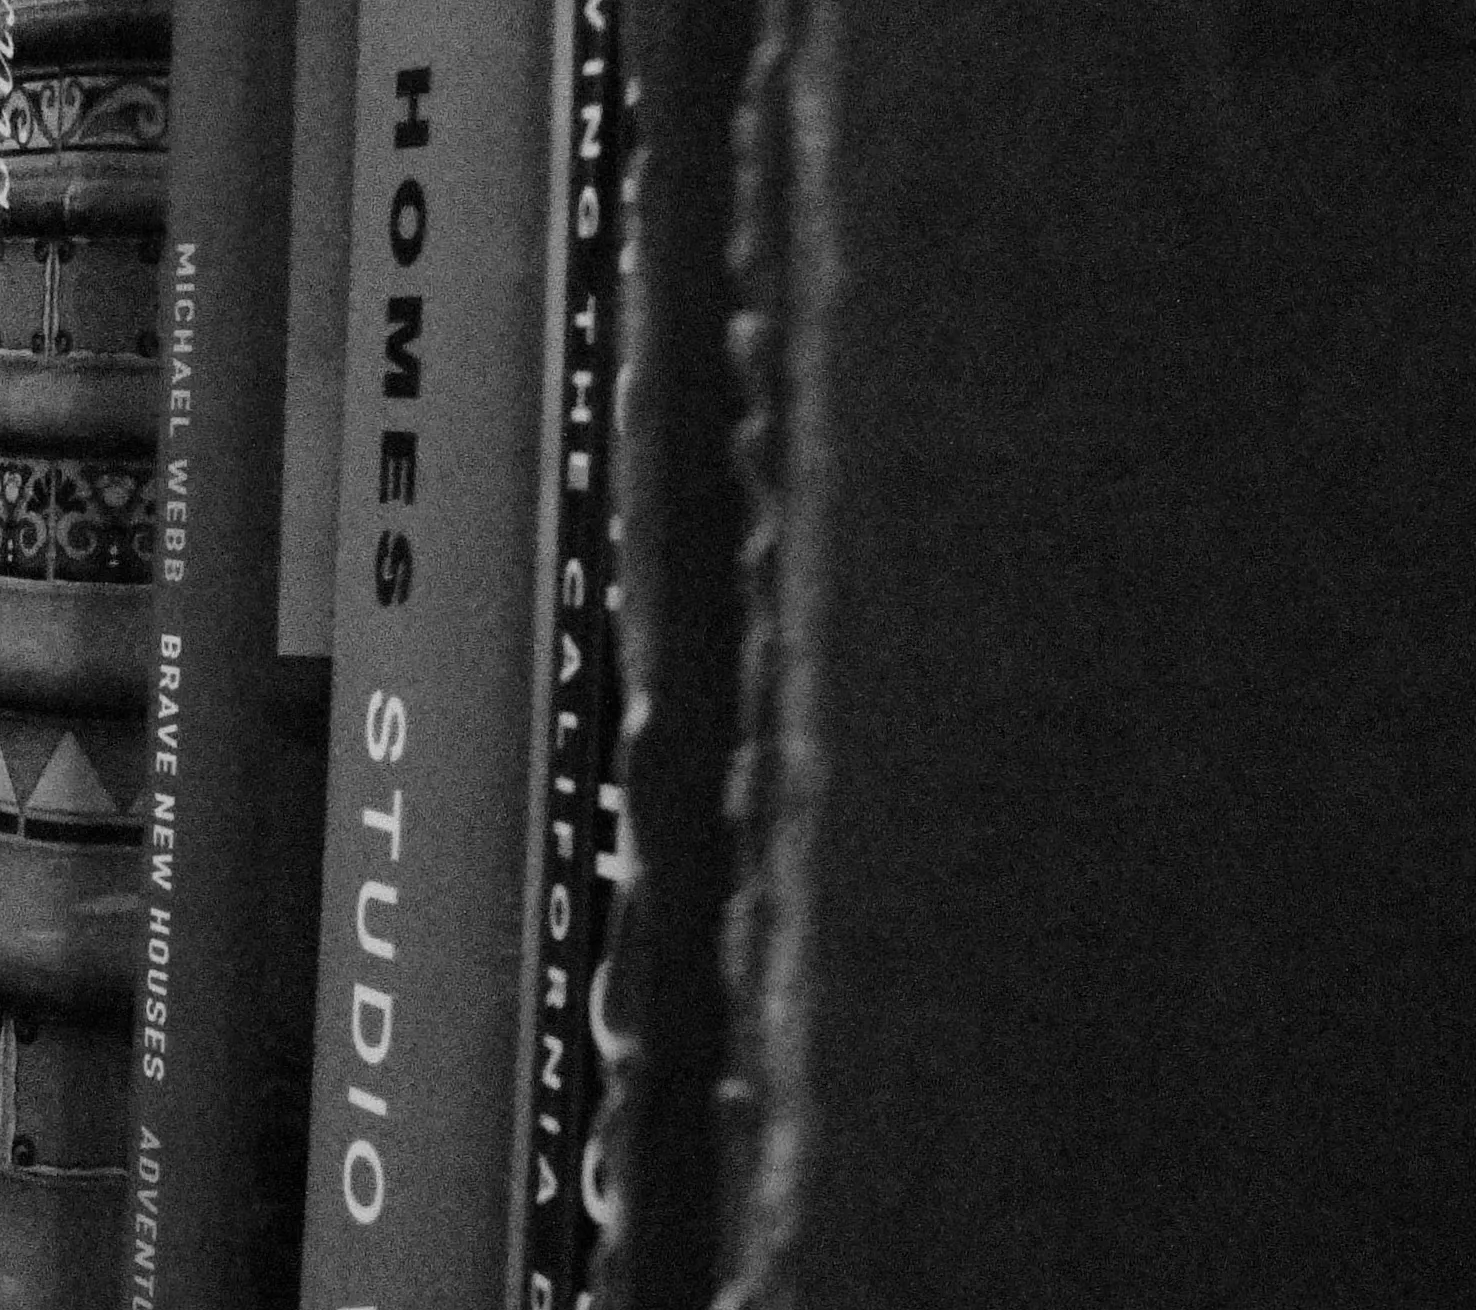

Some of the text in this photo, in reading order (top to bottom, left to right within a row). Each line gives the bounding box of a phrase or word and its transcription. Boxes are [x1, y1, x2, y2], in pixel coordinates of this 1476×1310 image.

[170, 242, 200, 438] MICHAEL
[373, 64, 433, 609] HOMES
[561, 294, 596, 489] THE
[164, 458, 188, 585] WEBB
[155, 632, 183, 776] BRAVE
[150, 789, 176, 892] NEW
[533, 557, 586, 1207] CALIFORNIA
[142, 905, 173, 1083] HOUSES
[341, 689, 409, 1229] STUDIO
